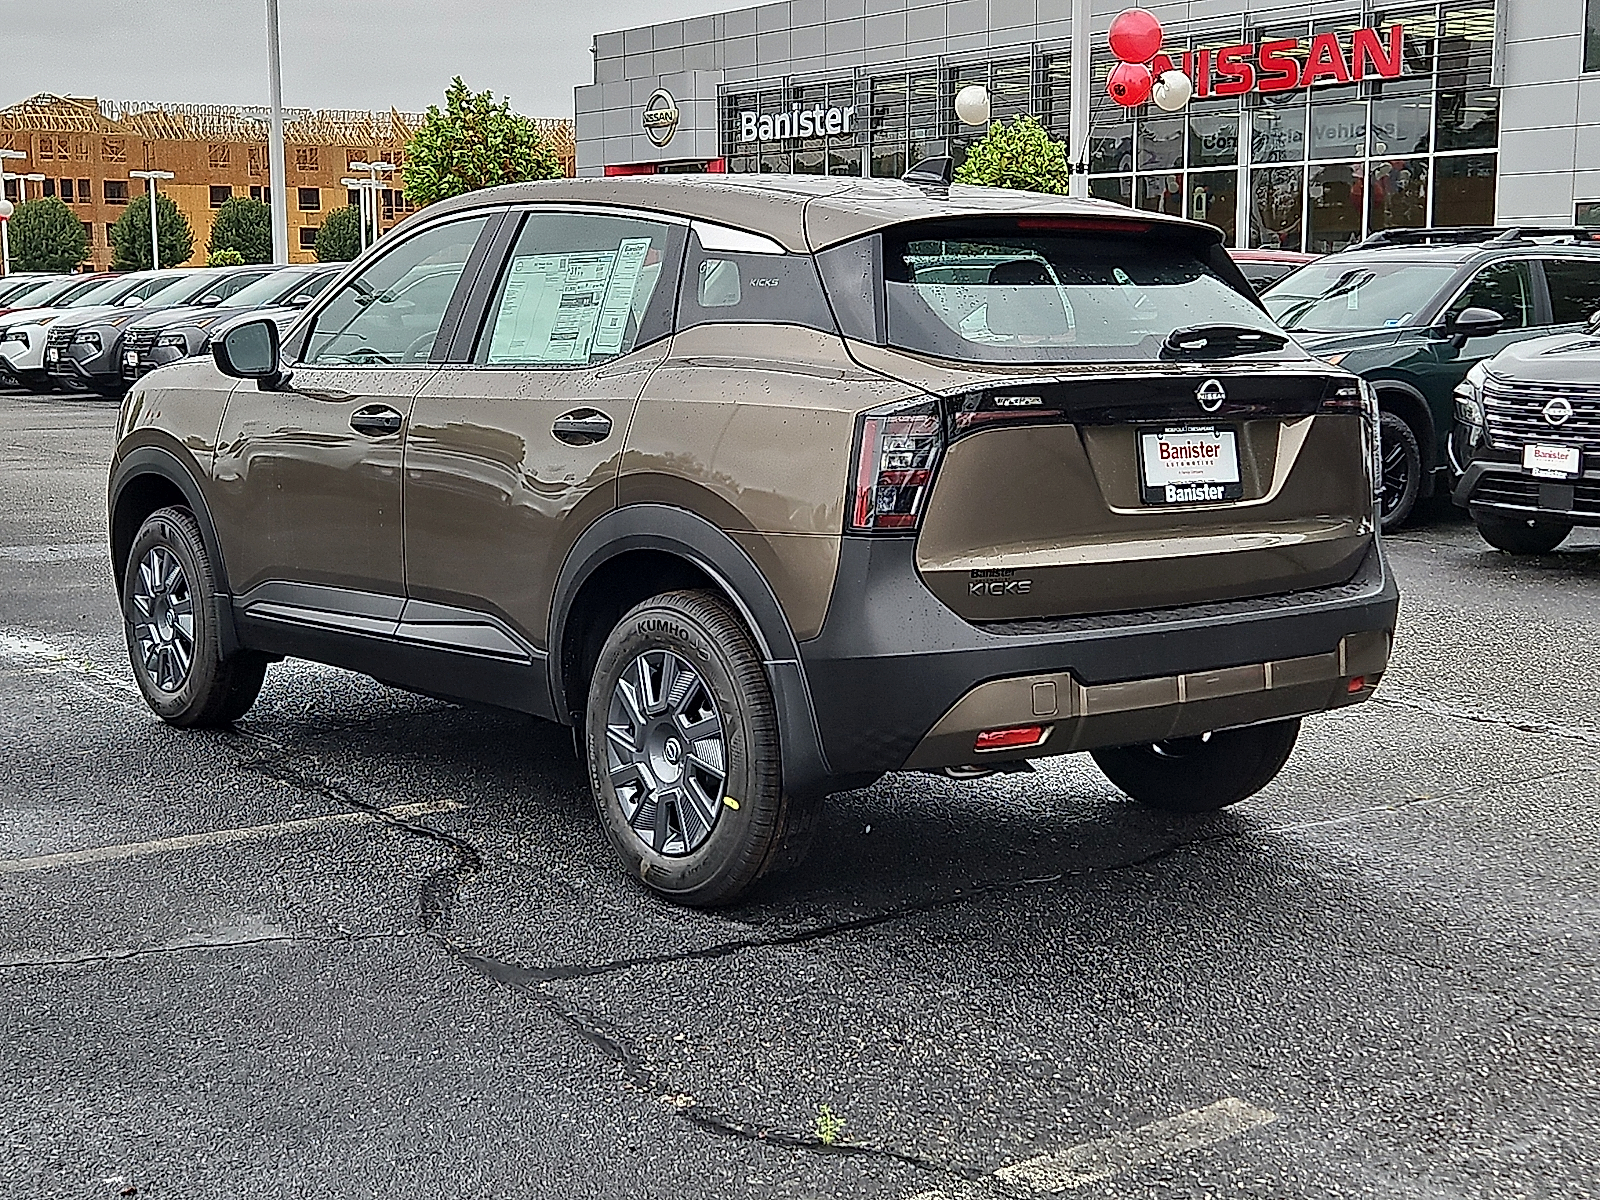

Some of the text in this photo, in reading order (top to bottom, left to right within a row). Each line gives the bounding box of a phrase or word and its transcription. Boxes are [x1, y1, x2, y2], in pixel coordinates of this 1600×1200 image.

[741, 102, 854, 141] Banister
[749, 278, 780, 287] KICKS
[1159, 441, 1220, 459] Banister
[1534, 449, 1569, 460] Banister
[1165, 483, 1225, 502] Banister
[968, 581, 1032, 596] KICKS
[636, 618, 690, 641] KUMHO
